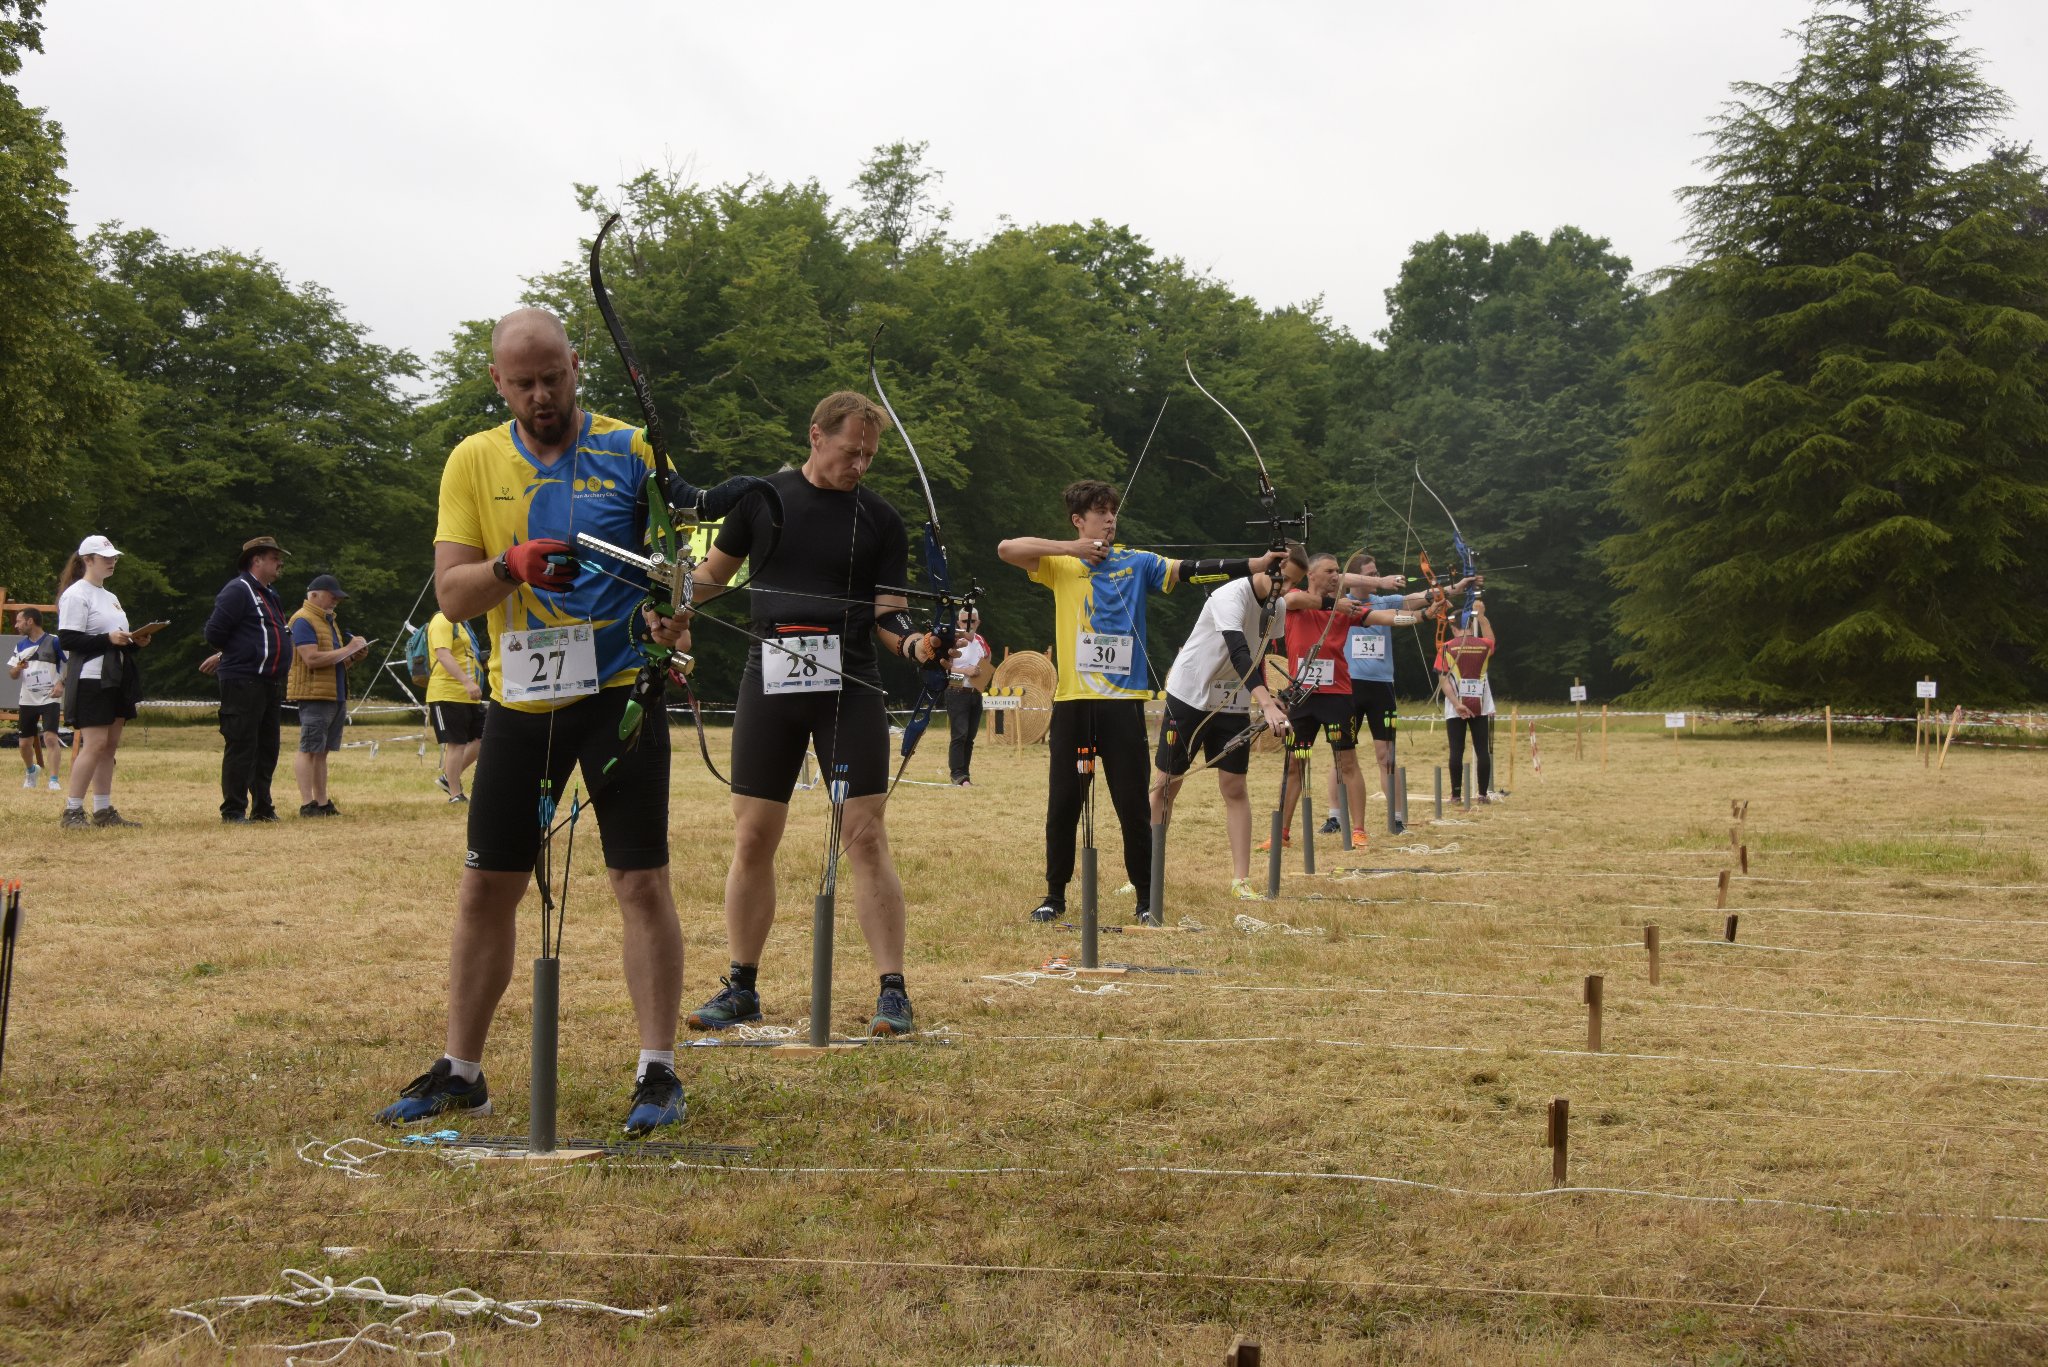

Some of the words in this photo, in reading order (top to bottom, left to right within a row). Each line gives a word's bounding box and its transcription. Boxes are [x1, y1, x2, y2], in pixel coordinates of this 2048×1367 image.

[1092, 646, 1116, 664] 30
[1361, 642, 1376, 653] 34
[529, 650, 566, 683] 27
[786, 653, 818, 678] 28
[1467, 684, 1477, 693] 12
